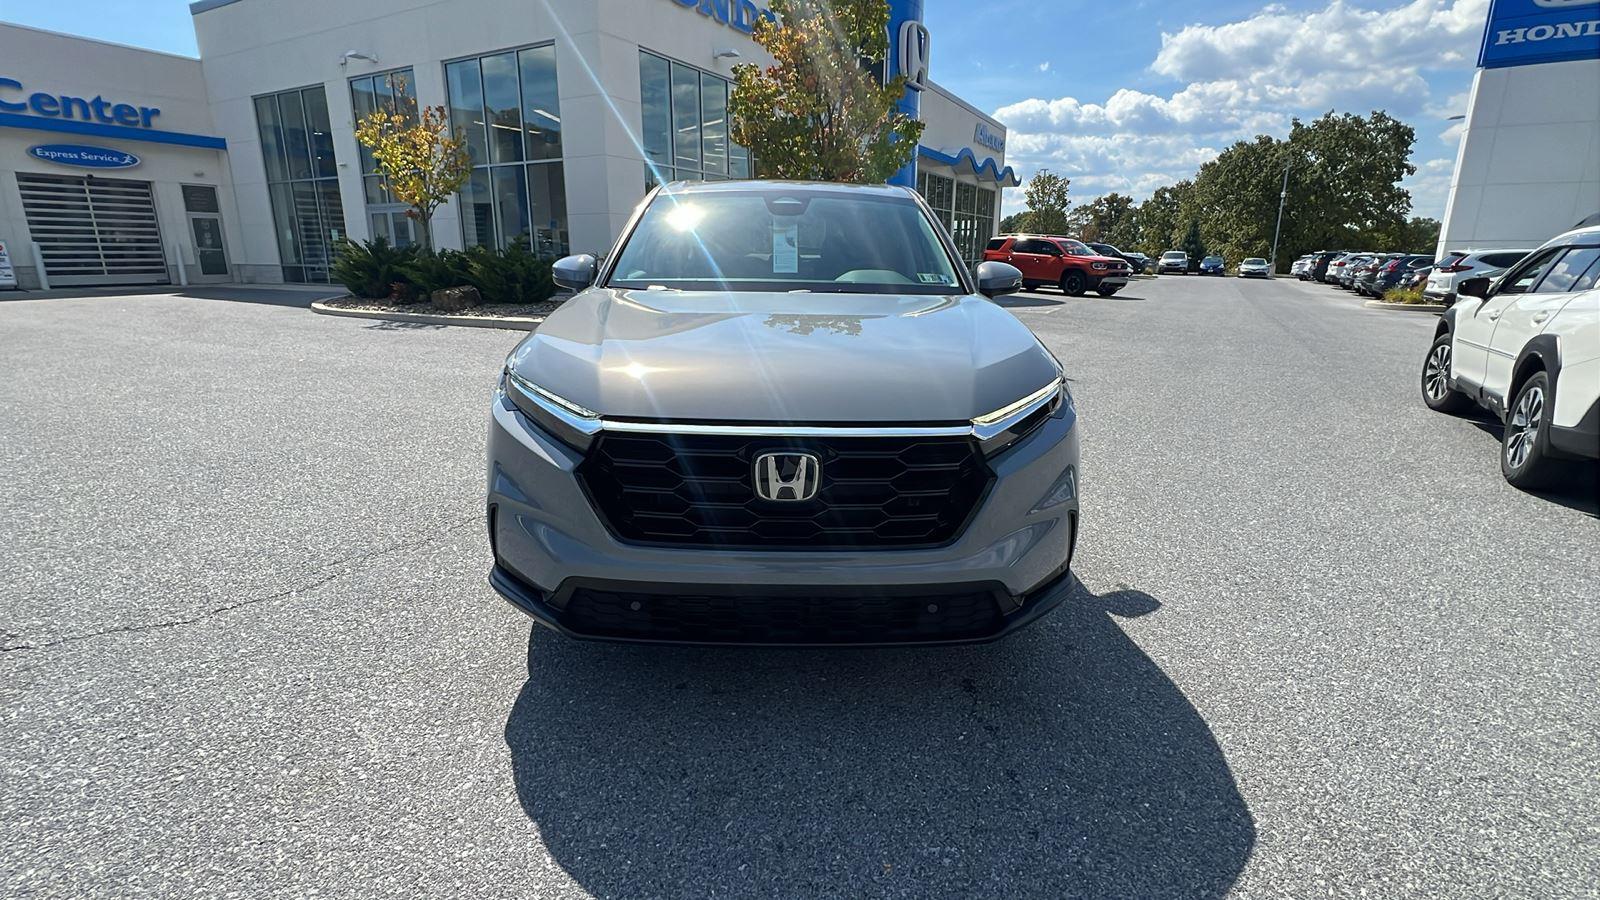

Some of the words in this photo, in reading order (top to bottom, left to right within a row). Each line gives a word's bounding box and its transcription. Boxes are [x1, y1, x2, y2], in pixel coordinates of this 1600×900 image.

[0, 77, 161, 127] Center
[36, 148, 79, 159] Express
[80, 152, 119, 162] Service
